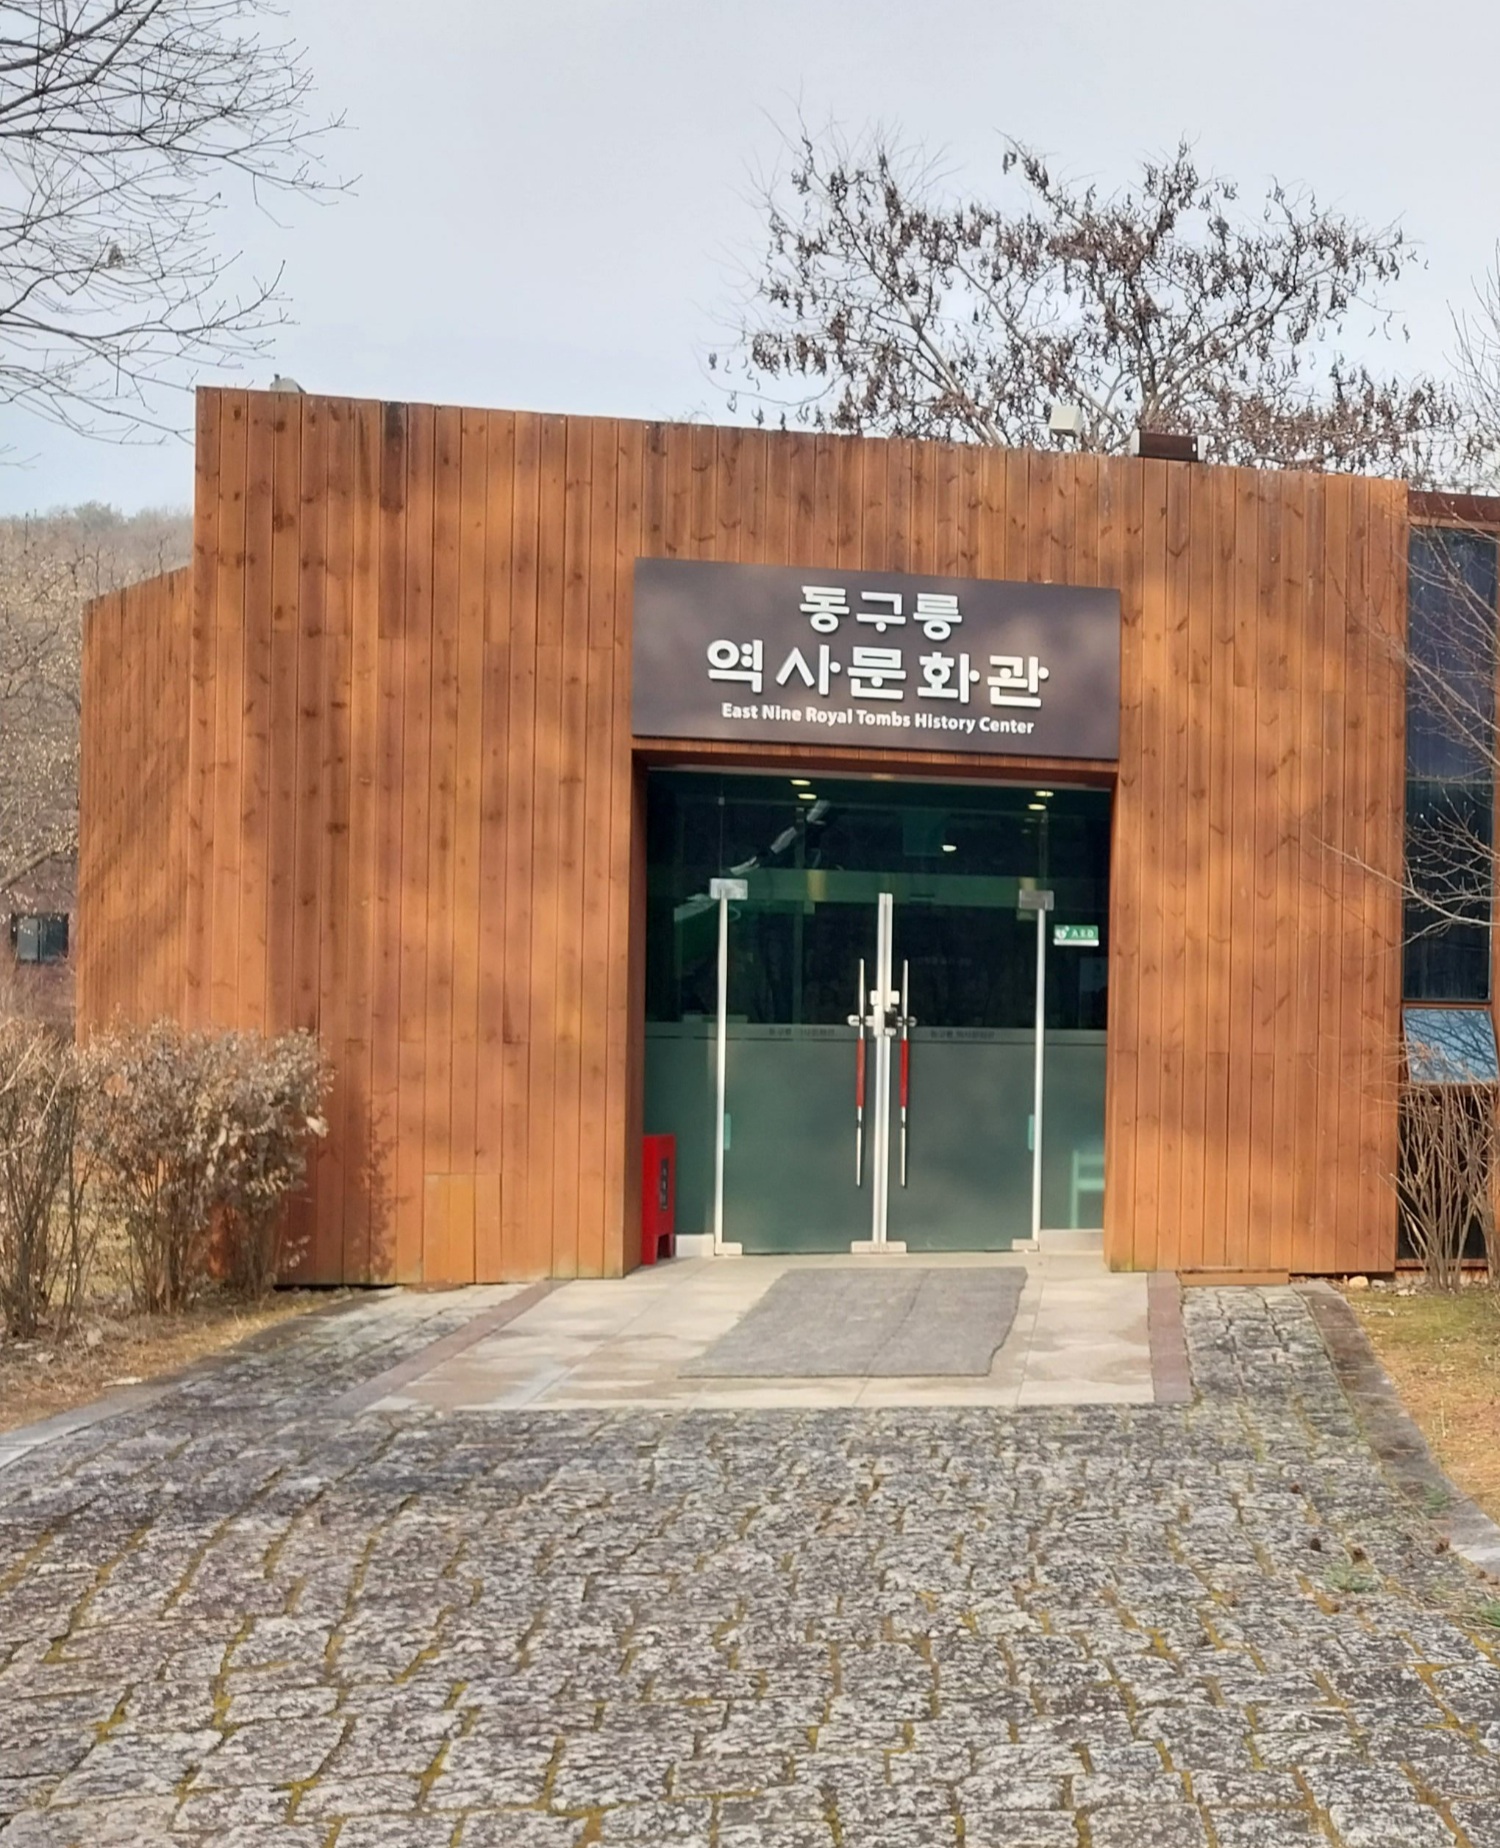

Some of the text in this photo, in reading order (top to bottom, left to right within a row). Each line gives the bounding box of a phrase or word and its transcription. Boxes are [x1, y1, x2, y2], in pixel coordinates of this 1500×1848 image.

[799, 585, 963, 641] 동구릉
[706, 639, 1050, 708] 역사문화관
[721, 702, 1035, 735] East Nine Royal Tombs History Center
